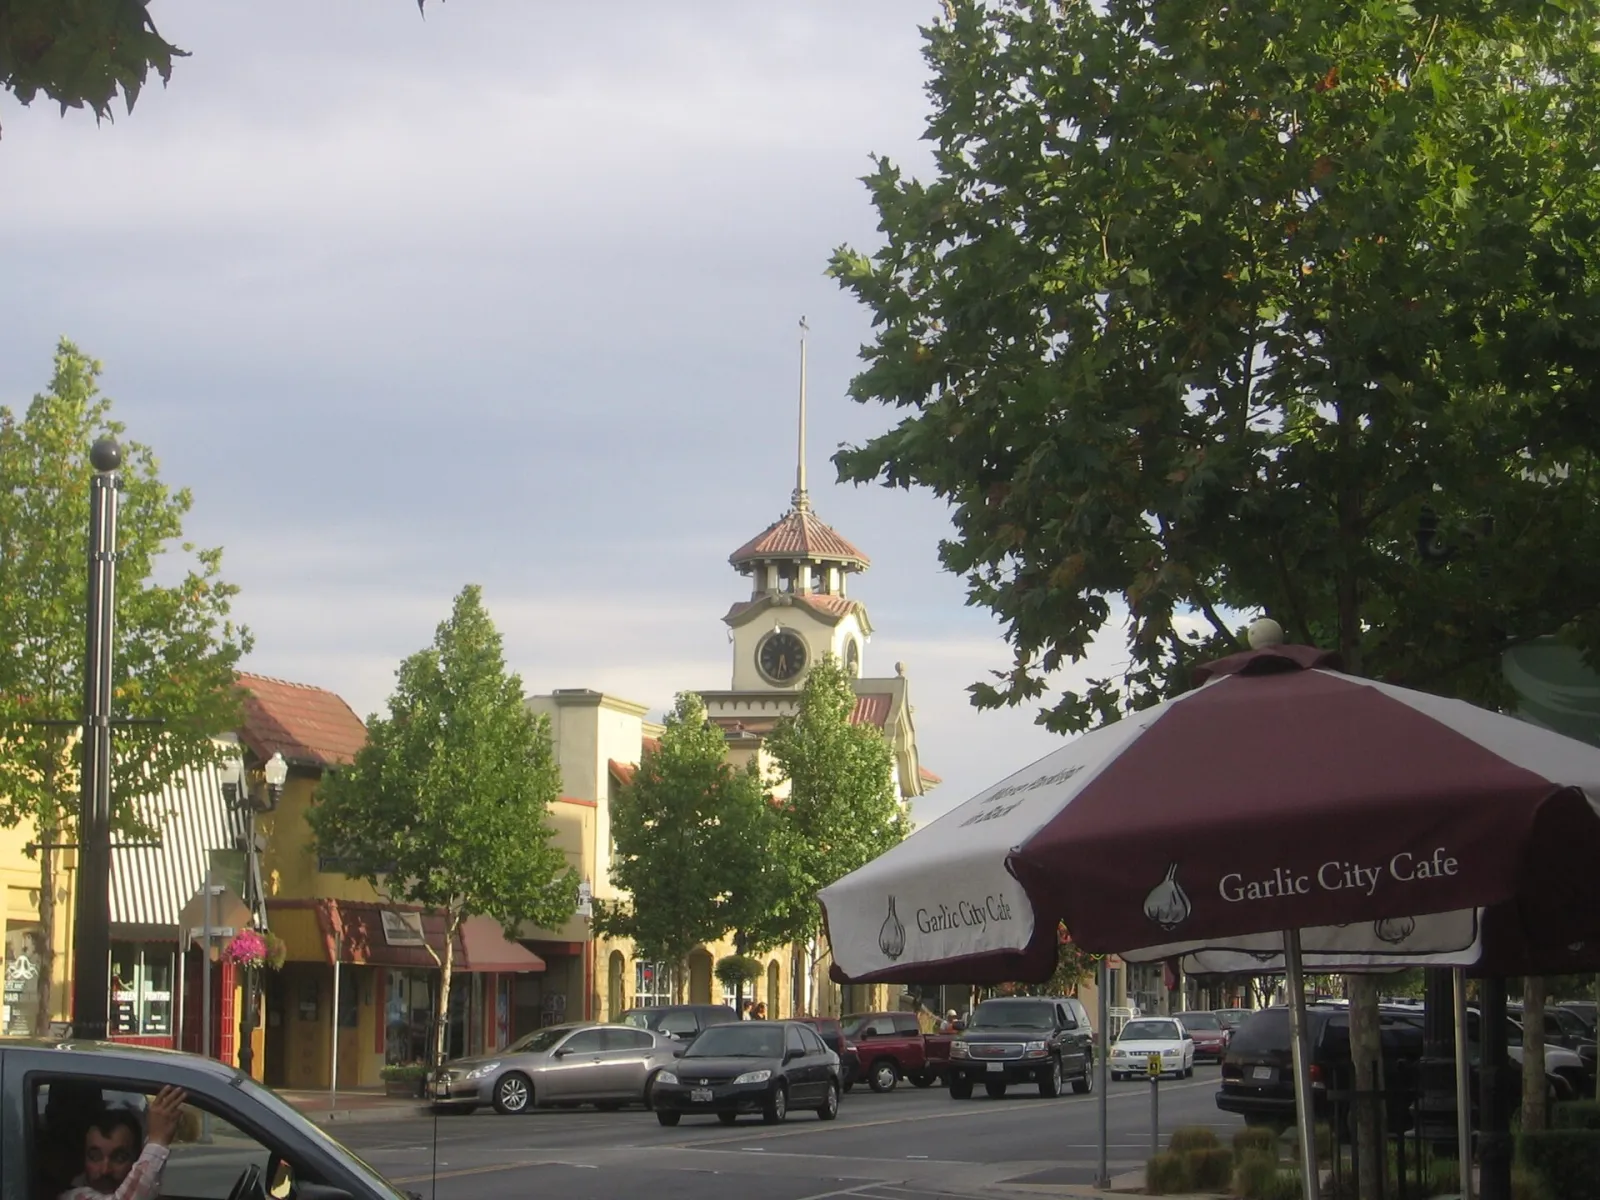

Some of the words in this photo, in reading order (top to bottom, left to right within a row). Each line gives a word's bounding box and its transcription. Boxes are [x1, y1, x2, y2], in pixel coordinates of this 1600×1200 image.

[1218, 867, 1311, 902] Garlic
[1317, 861, 1382, 896] City
[1389, 847, 1459, 882] Cafe
[916, 905, 960, 934] Garlic
[958, 900, 988, 933] City
[986, 893, 1012, 922] Cafe
